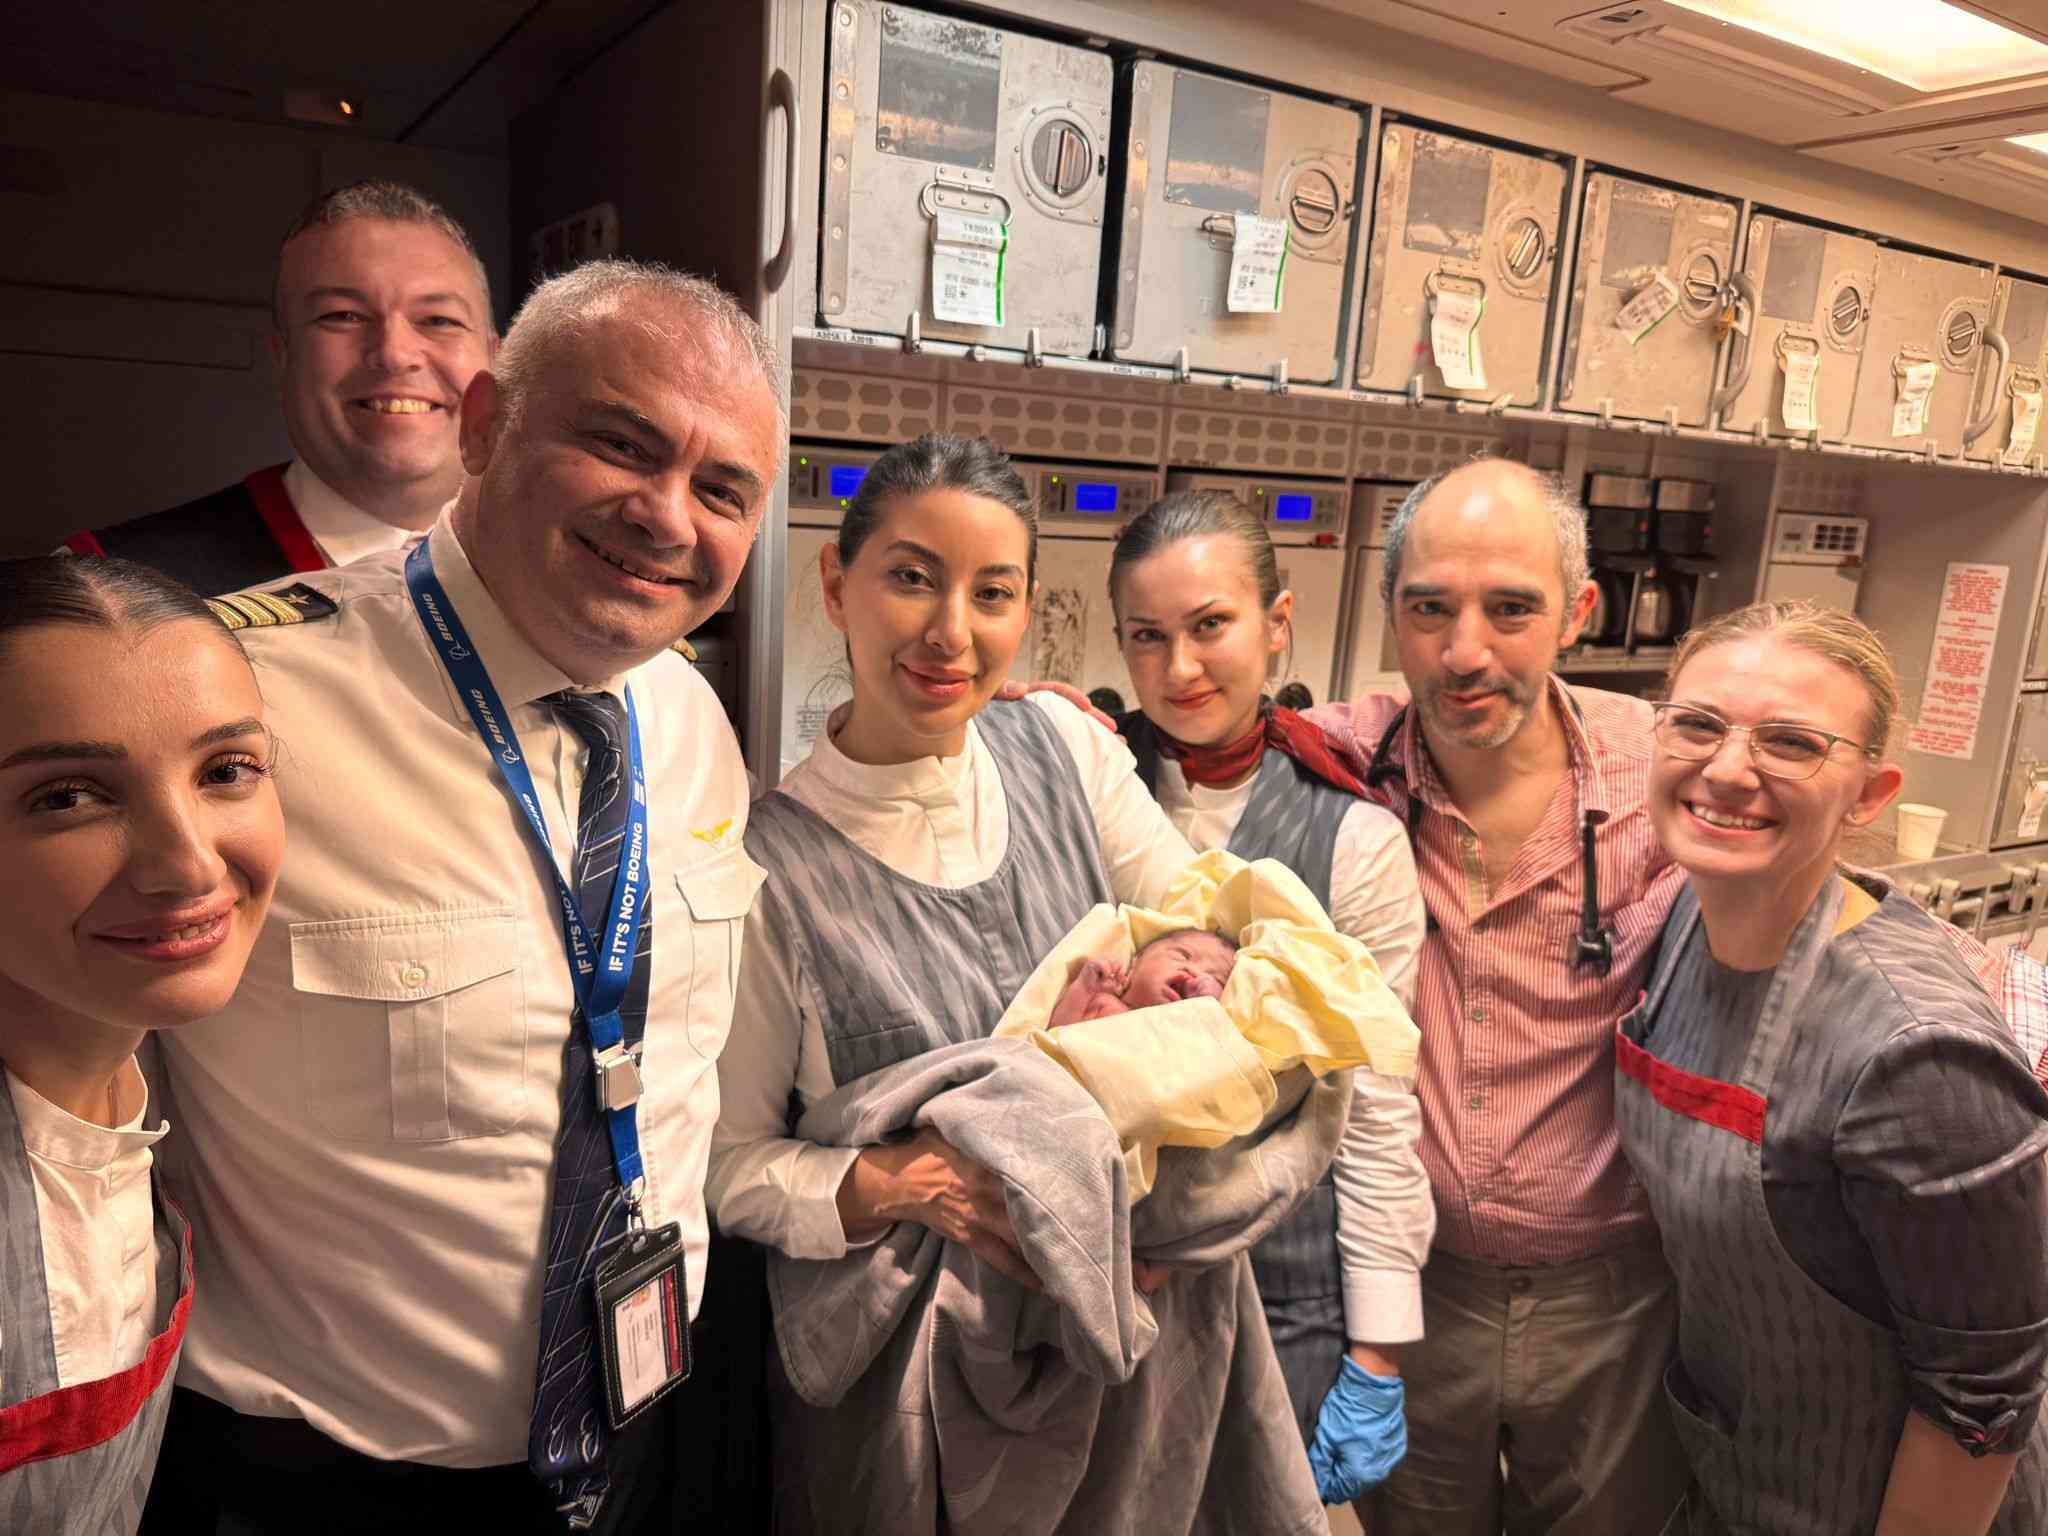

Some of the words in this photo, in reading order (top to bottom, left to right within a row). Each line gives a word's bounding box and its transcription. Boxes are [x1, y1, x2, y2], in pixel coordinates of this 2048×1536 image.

[422, 593, 454, 641] BOEING
[471, 688, 506, 745] BOEING
[626, 822, 643, 882] BOEING
[561, 890, 577, 921] NO
[618, 883, 637, 920] NOT
[570, 925, 588, 956] IT'S
[612, 922, 630, 953] IT'S
[577, 959, 593, 975] IF
[608, 955, 624, 972] IF
